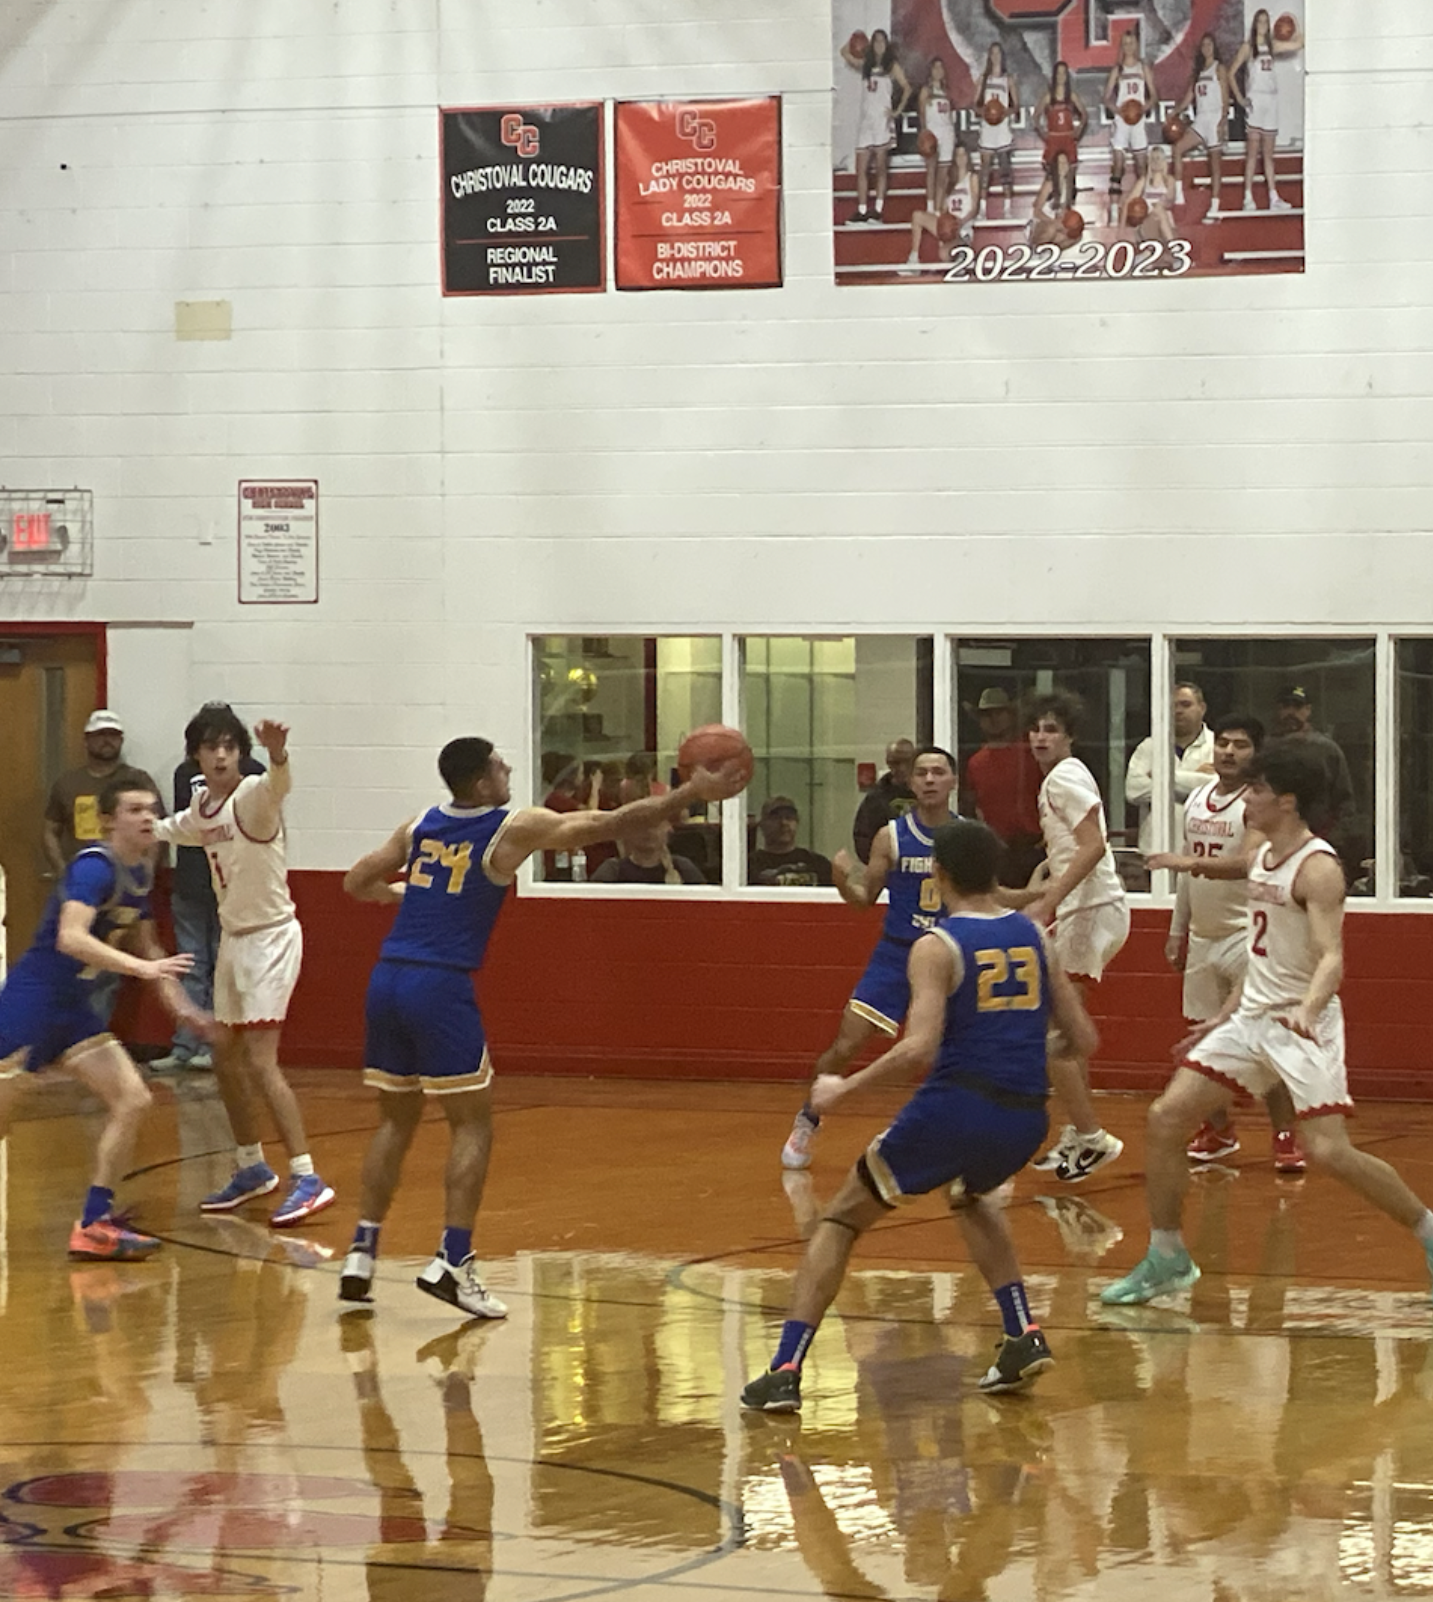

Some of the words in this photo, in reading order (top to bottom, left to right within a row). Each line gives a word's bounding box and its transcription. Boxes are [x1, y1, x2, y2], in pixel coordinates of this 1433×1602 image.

[501, 113, 540, 158] CC
[676, 108, 716, 151] CC
[651, 158, 744, 176] CHRISTOVAL
[451, 163, 526, 198] CHRISTOVAL
[528, 162, 593, 194] COUGARS
[639, 178, 679, 196] LADY
[682, 174, 756, 193] COUGARS
[506, 199, 535, 213] 2022
[684, 194, 713, 208] 2022
[487, 217, 535, 233] CLASS
[537, 216, 558, 231] 2A
[662, 212, 710, 227] CLASS
[713, 211, 732, 225] 2A
[487, 246, 558, 264] REGIONAL
[657, 240, 738, 259] BI-DISTRICT
[652, 259, 744, 280] CHAMPIONS
[943, 239, 1194, 282] 2022-2023
[489, 265, 555, 285] FINALIST
[211, 852, 227, 889] 1
[409, 838, 473, 894] 24
[901, 857, 936, 873] FIGH
[919, 878, 941, 912] 0
[1252, 910, 1268, 958] 2
[974, 946, 1041, 1013] 23
